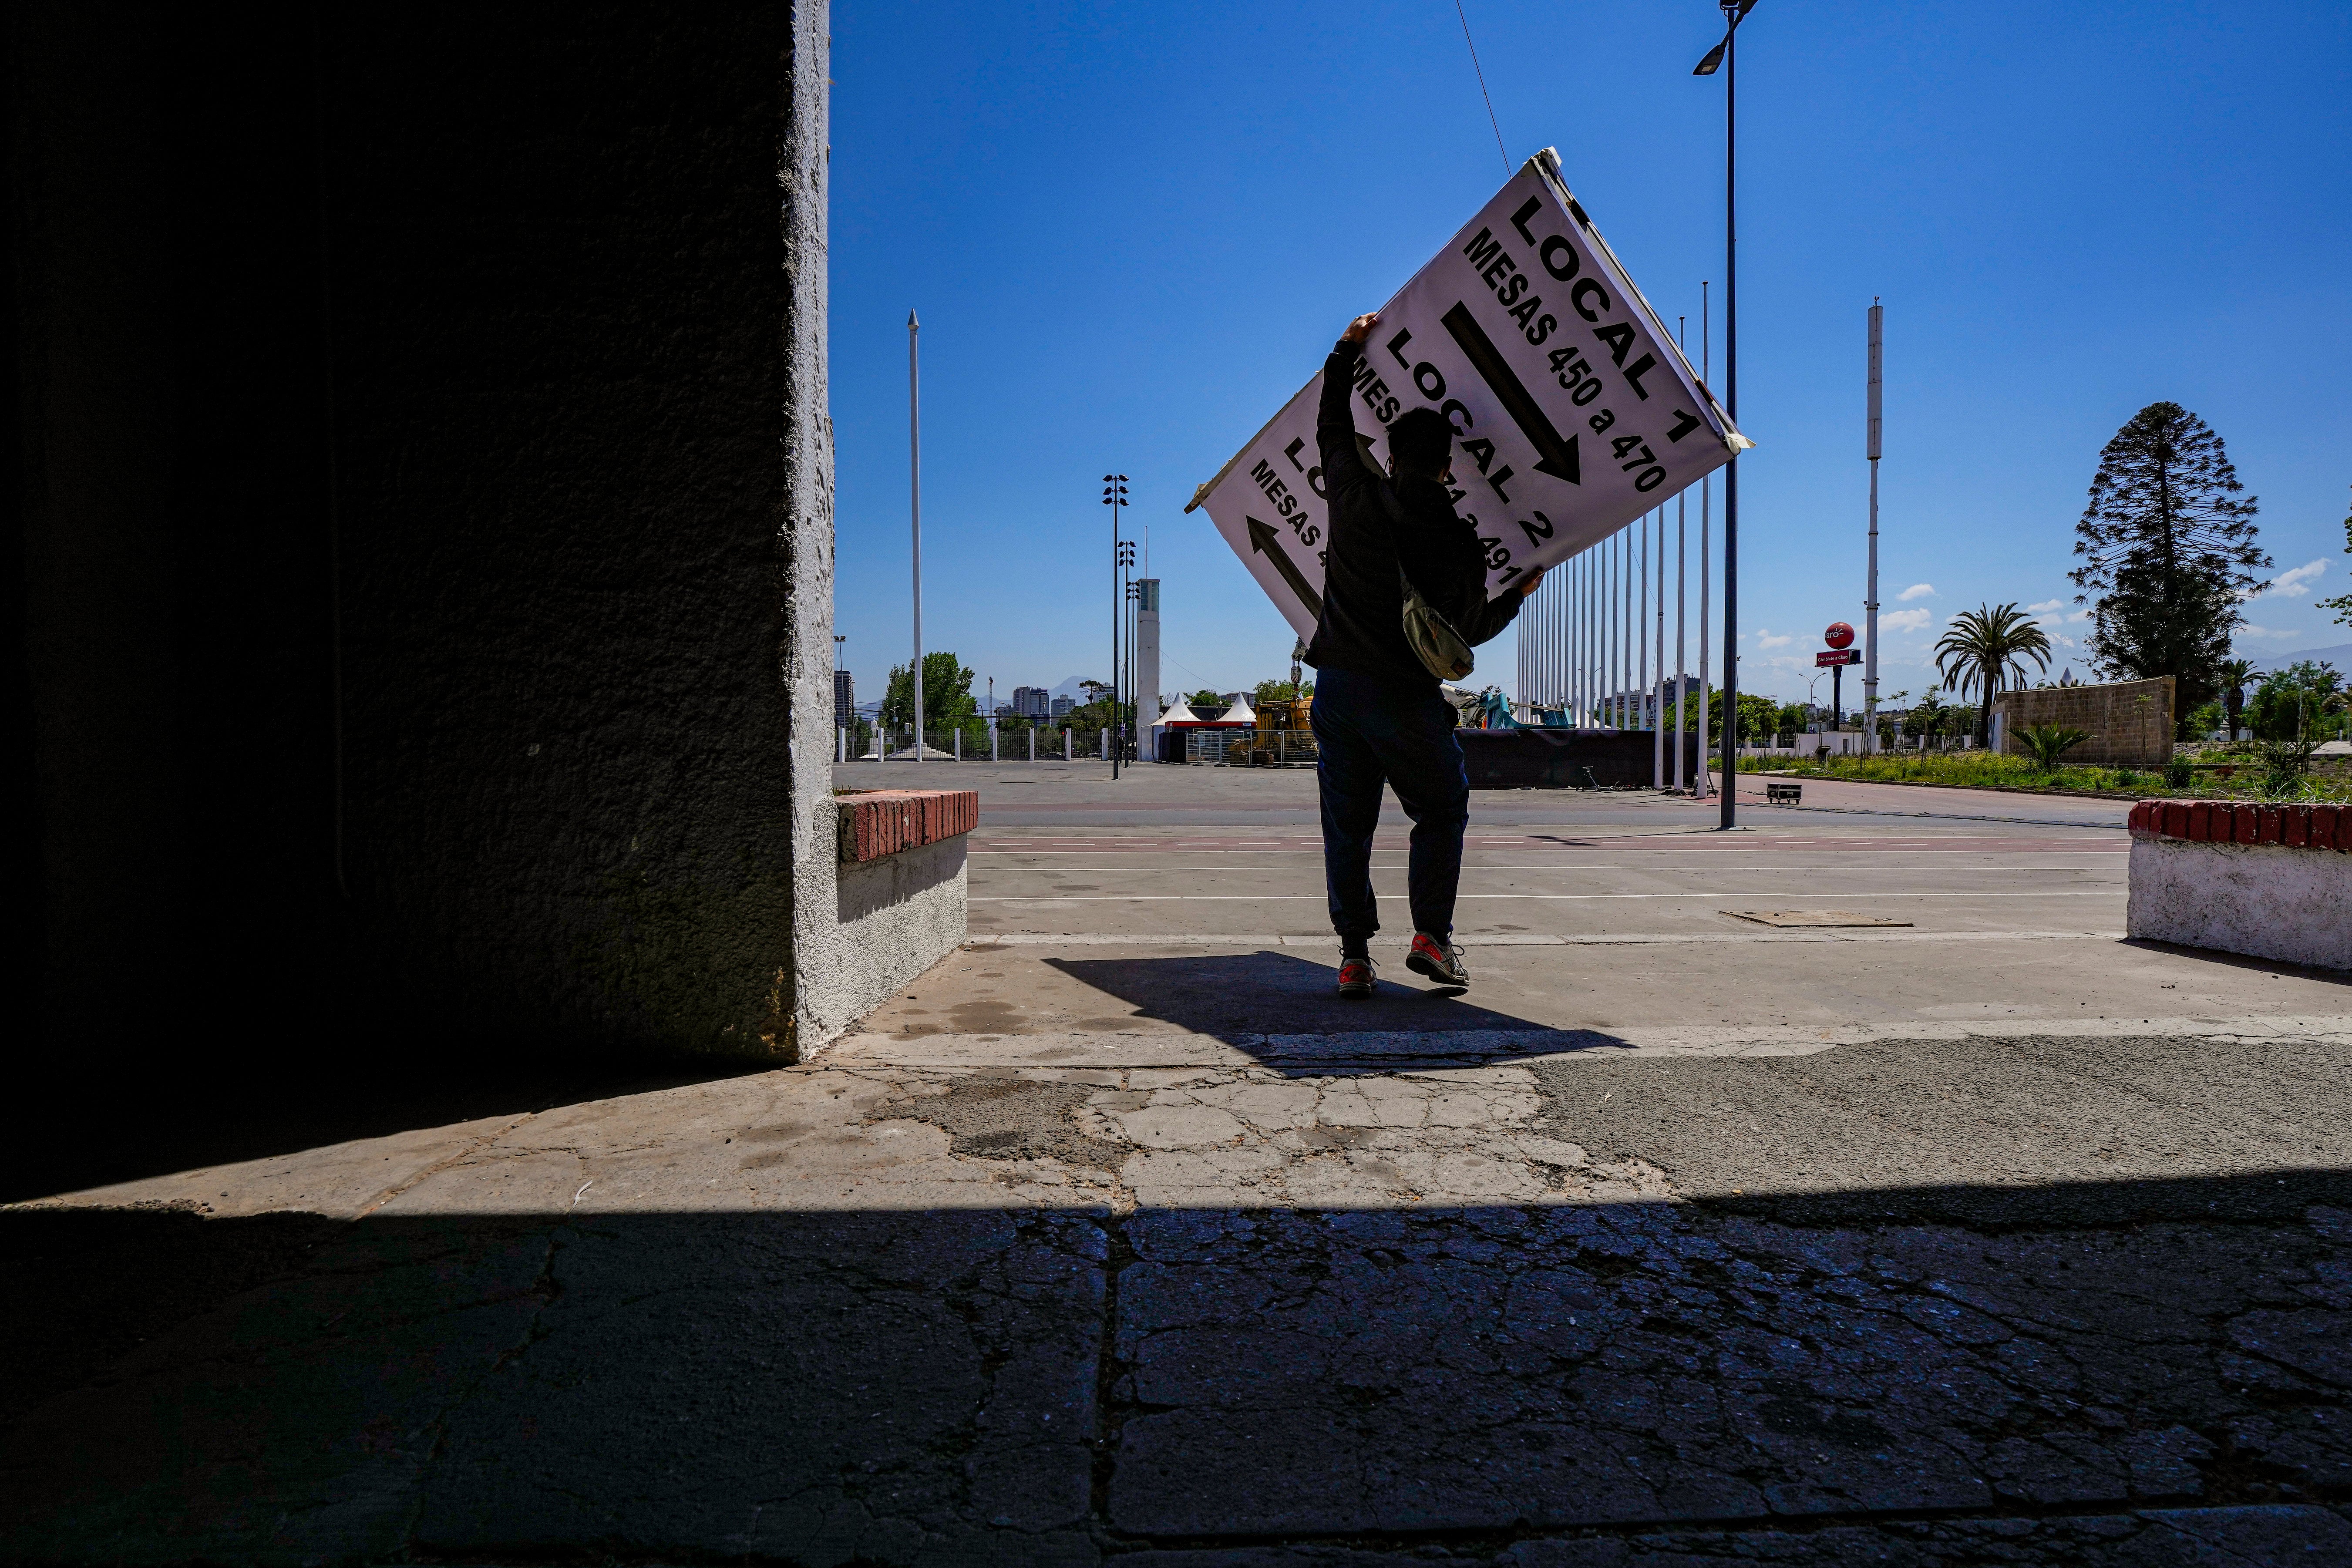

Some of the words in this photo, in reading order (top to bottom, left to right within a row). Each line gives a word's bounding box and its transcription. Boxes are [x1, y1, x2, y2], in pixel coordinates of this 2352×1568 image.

[1463, 226, 1557, 346] MESAS
[1548, 347, 1602, 406] 450
[1589, 409, 1615, 436] a
[1611, 435, 1666, 492] 470
[1510, 194, 1657, 401] LOCAL
[1666, 409, 1701, 444] 1
[1250, 458, 1321, 546] MESAS
[1386, 327, 1514, 505] LOCAL
[1518, 511, 1554, 548] 2
[1479, 537, 1524, 585] 491
